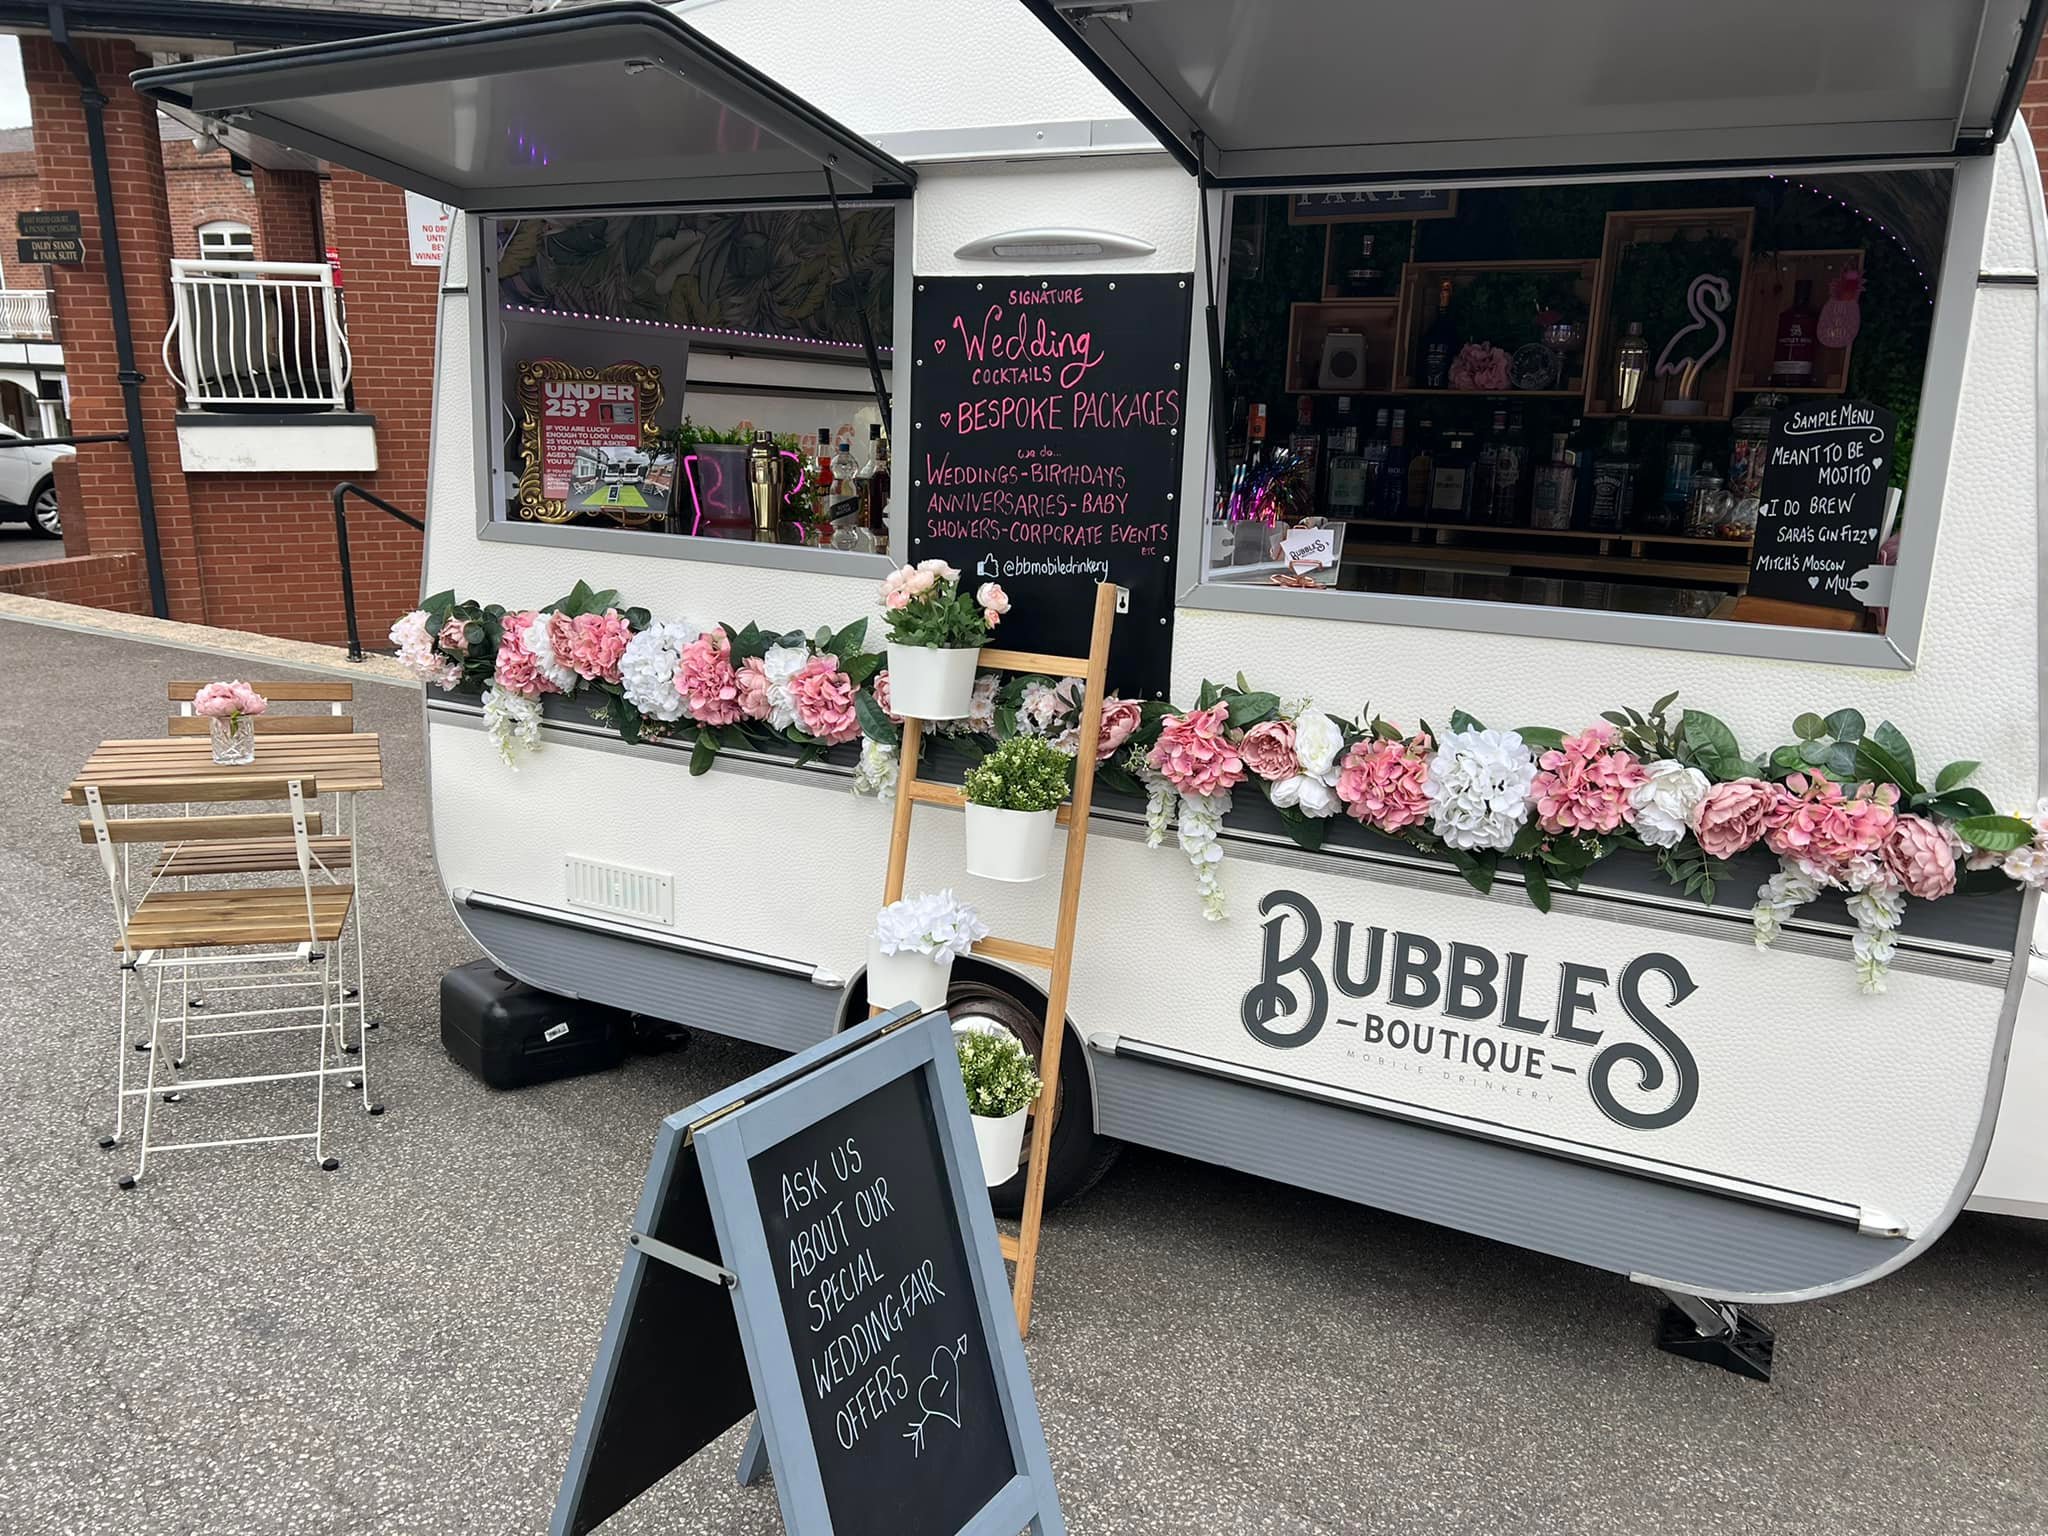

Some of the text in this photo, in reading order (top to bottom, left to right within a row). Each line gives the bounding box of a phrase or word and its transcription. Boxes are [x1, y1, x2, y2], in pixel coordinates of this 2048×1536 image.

[426, 234, 445, 242] UNTI
[435, 225, 447, 233] DR
[33, 251, 78, 260] & PARK SUITE
[52, 241, 75, 250] STAND
[415, 252, 443, 260] WINNE
[1008, 287, 1085, 305] SIGNATURE
[952, 304, 1105, 389] Wedding
[972, 366, 1053, 385] COCKTAILS
[544, 382, 636, 401] UNDER
[545, 399, 590, 418] 25?
[957, 389, 1180, 435] BESPOKE PACKAGES
[1792, 403, 1875, 429] SAMPLE MENU
[546, 431, 577, 439] ENOUGH
[590, 432, 610, 440] LOOK
[1771, 441, 1865, 466] MEANT TO BE
[1818, 464, 1871, 485] MOJITO
[1081, 492, 1129, 515] BABY
[1767, 492, 1857, 517] I DO BREW
[1110, 523, 1169, 544] EVENTS
[1776, 524, 1868, 545] SARA'S GIN FIZZ
[1002, 557, 1109, 584] @bbmobiledrinkery
[1755, 554, 1846, 573] MITCH'S MOSCOW
[1241, 888, 1700, 1131] BUBBLES
[1346, 1049, 1557, 1105] MOBILE DRINKERY
[781, 1136, 863, 1219] ASK US
[789, 1176, 896, 1289] ABOUT OUR
[808, 1247, 886, 1333] SPECIAL
[810, 1258, 946, 1400] WEDDING FAIR
[835, 1353, 909, 1451] OFFERS
